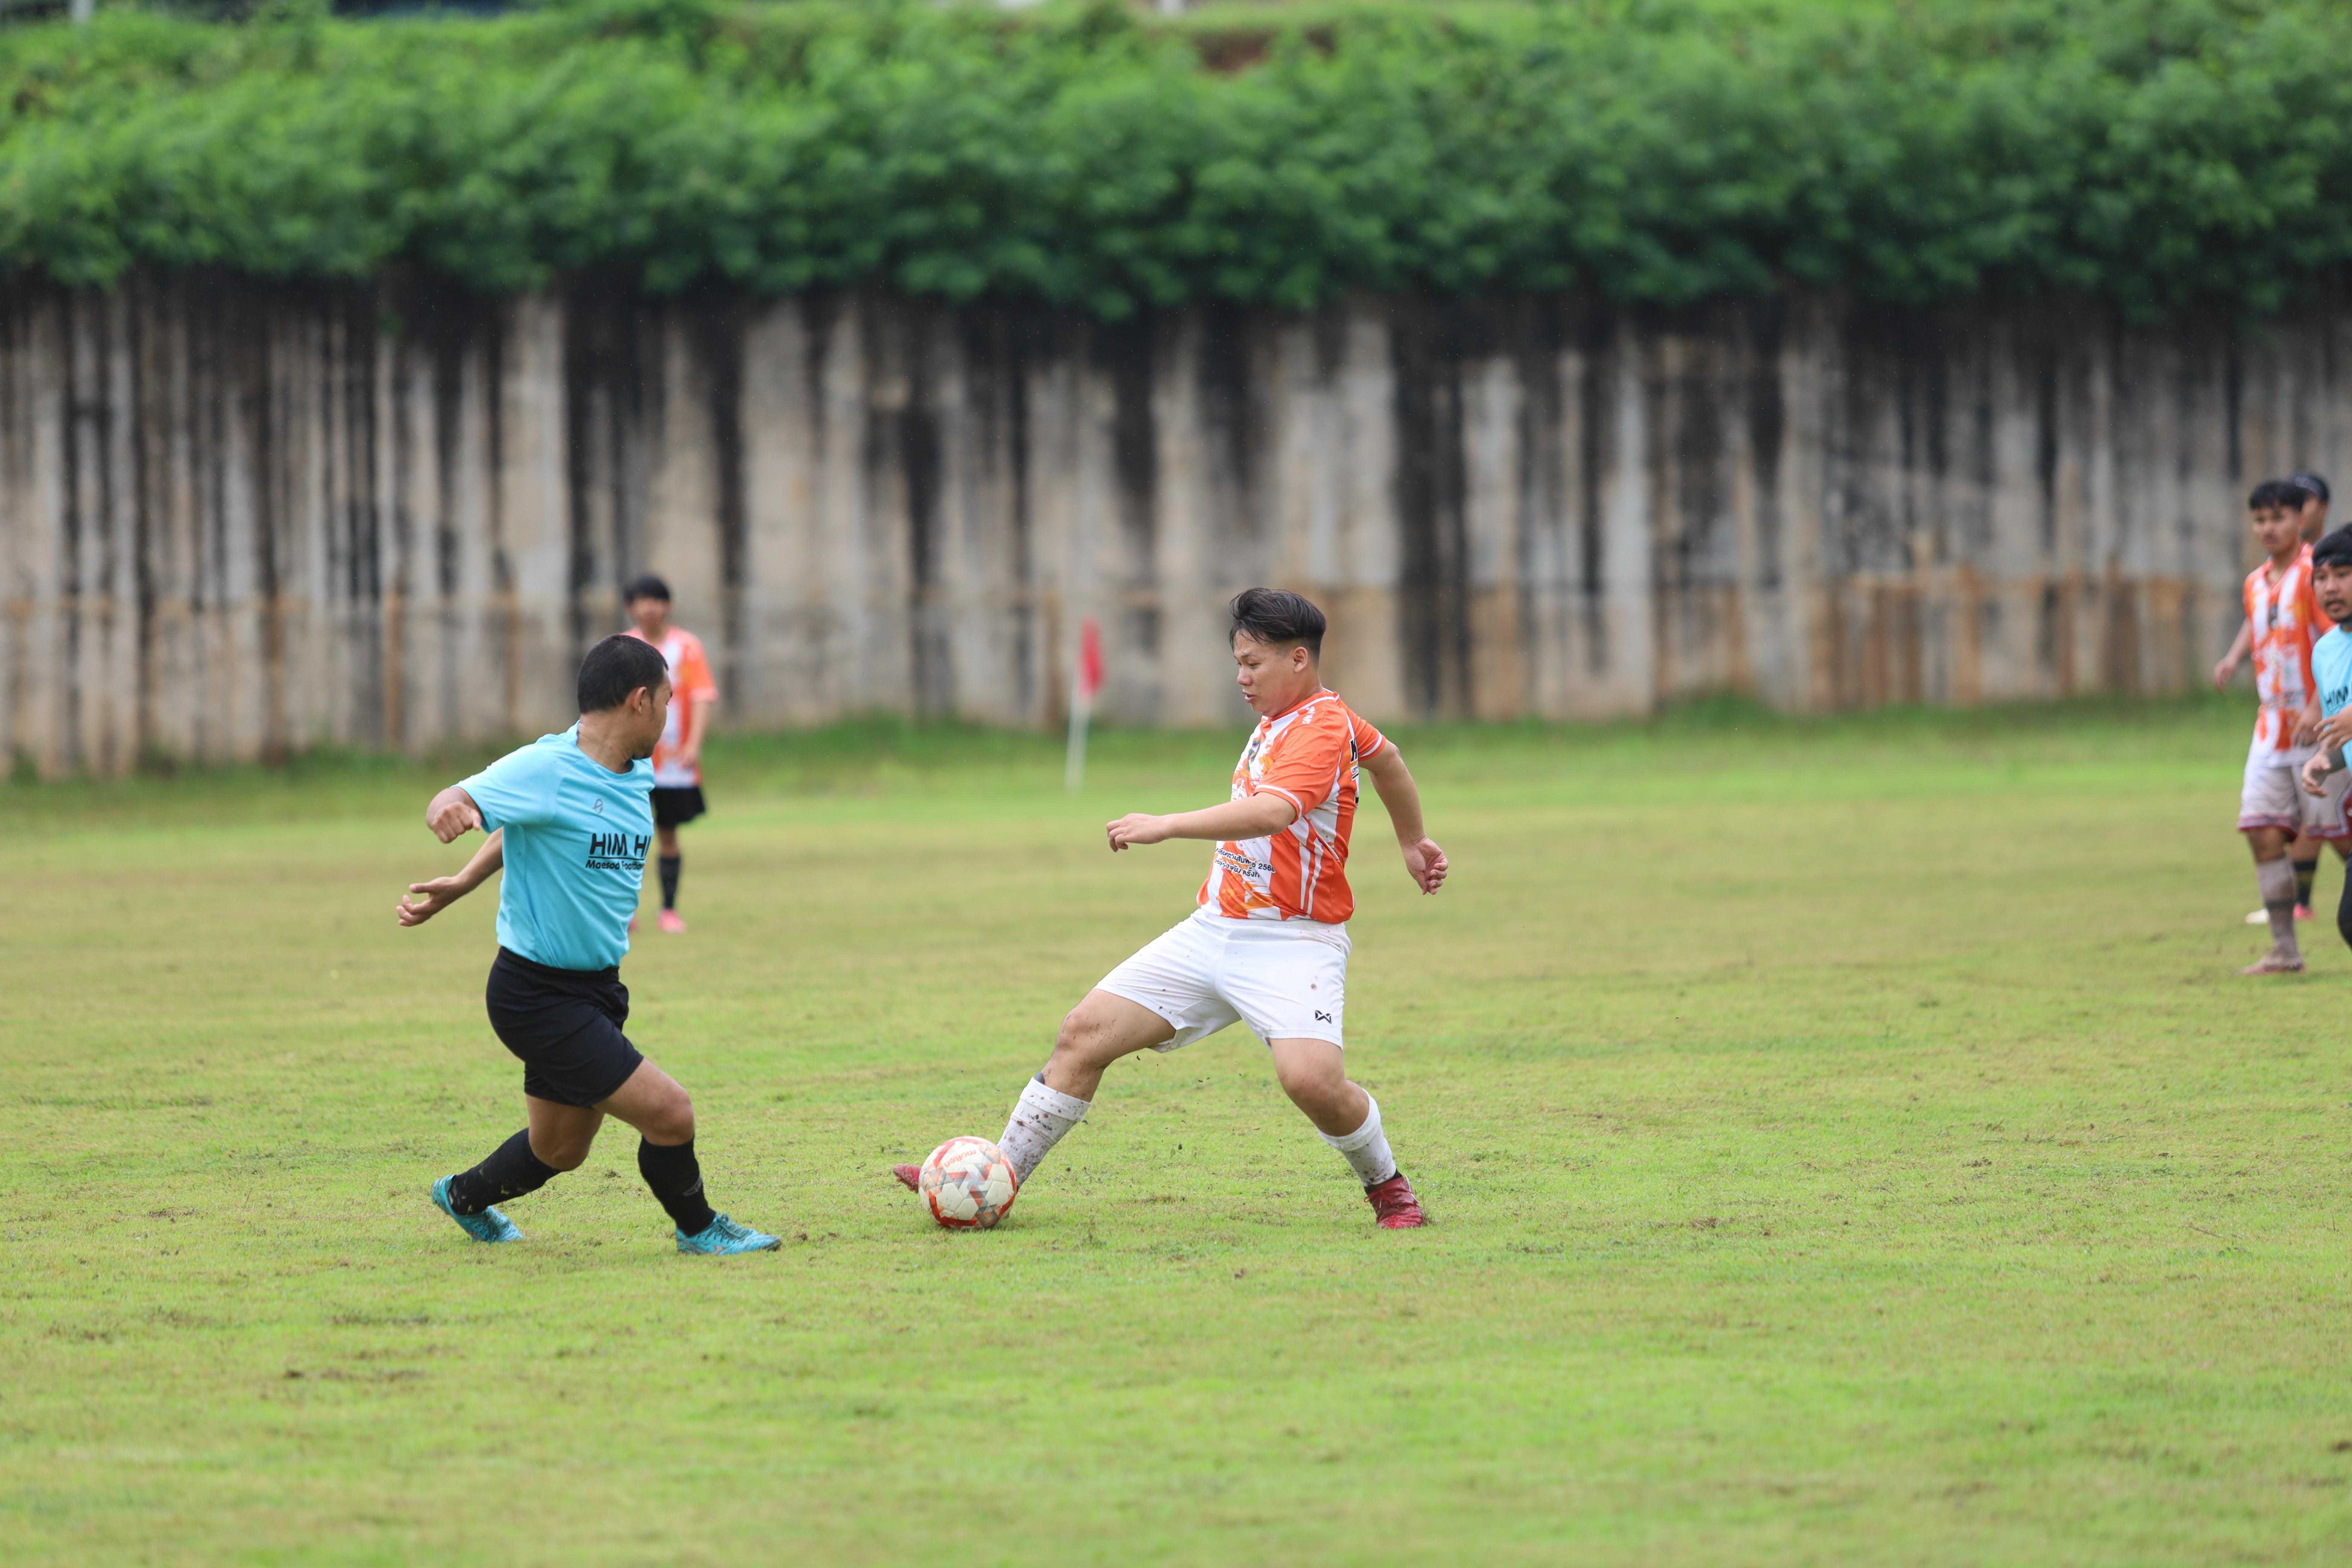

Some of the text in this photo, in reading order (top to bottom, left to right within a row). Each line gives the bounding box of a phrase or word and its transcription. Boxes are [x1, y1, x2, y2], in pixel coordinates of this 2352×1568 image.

[590, 833, 627, 856] HIM
[585, 859, 620, 870] Maesod
[945, 1150, 976, 1167] molten
